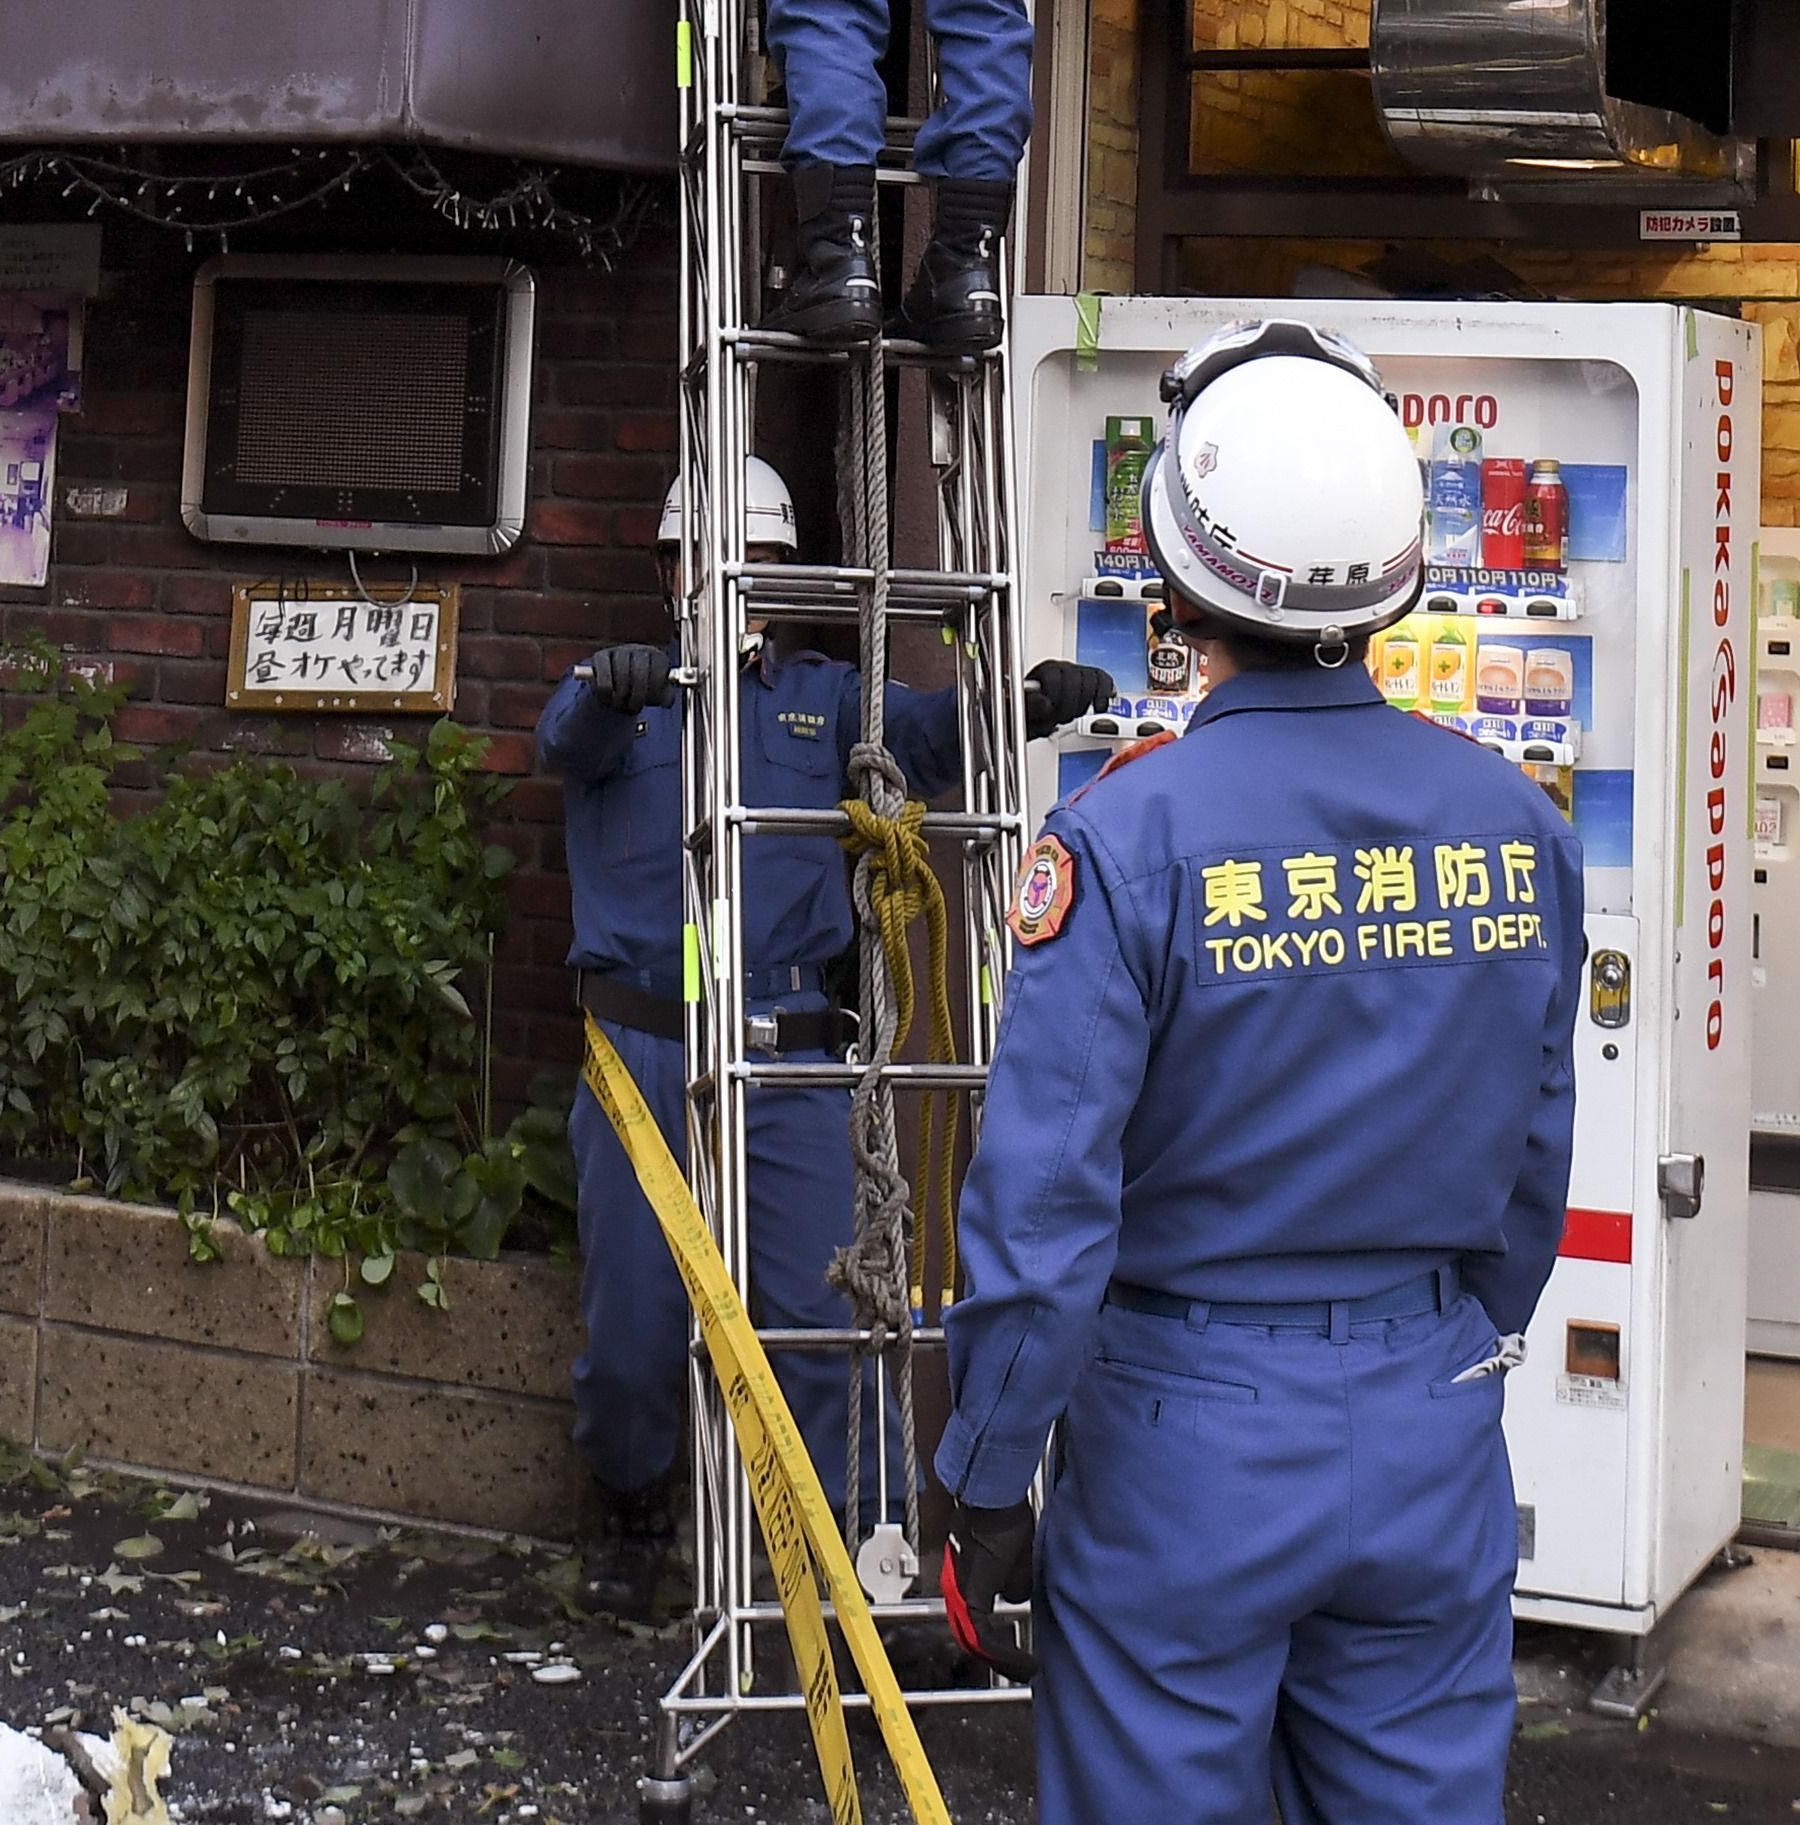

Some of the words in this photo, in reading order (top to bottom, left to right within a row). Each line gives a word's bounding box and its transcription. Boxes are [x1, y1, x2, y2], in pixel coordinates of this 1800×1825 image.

[1646, 216, 1735, 233] 防犯カメラ設置
[1095, 552, 1140, 569] 140円
[1460, 569, 1507, 586] 110円
[1510, 570, 1558, 588] 110円
[254, 606, 435, 648] 毎週月曜日
[248, 649, 431, 690] 昼オケやってます
[1201, 840, 1538, 929] 東京消防庁
[1204, 927, 1345, 974] TOKYO
[1357, 917, 1453, 961] FIRE
[1471, 912, 1548, 954] DEPT.
